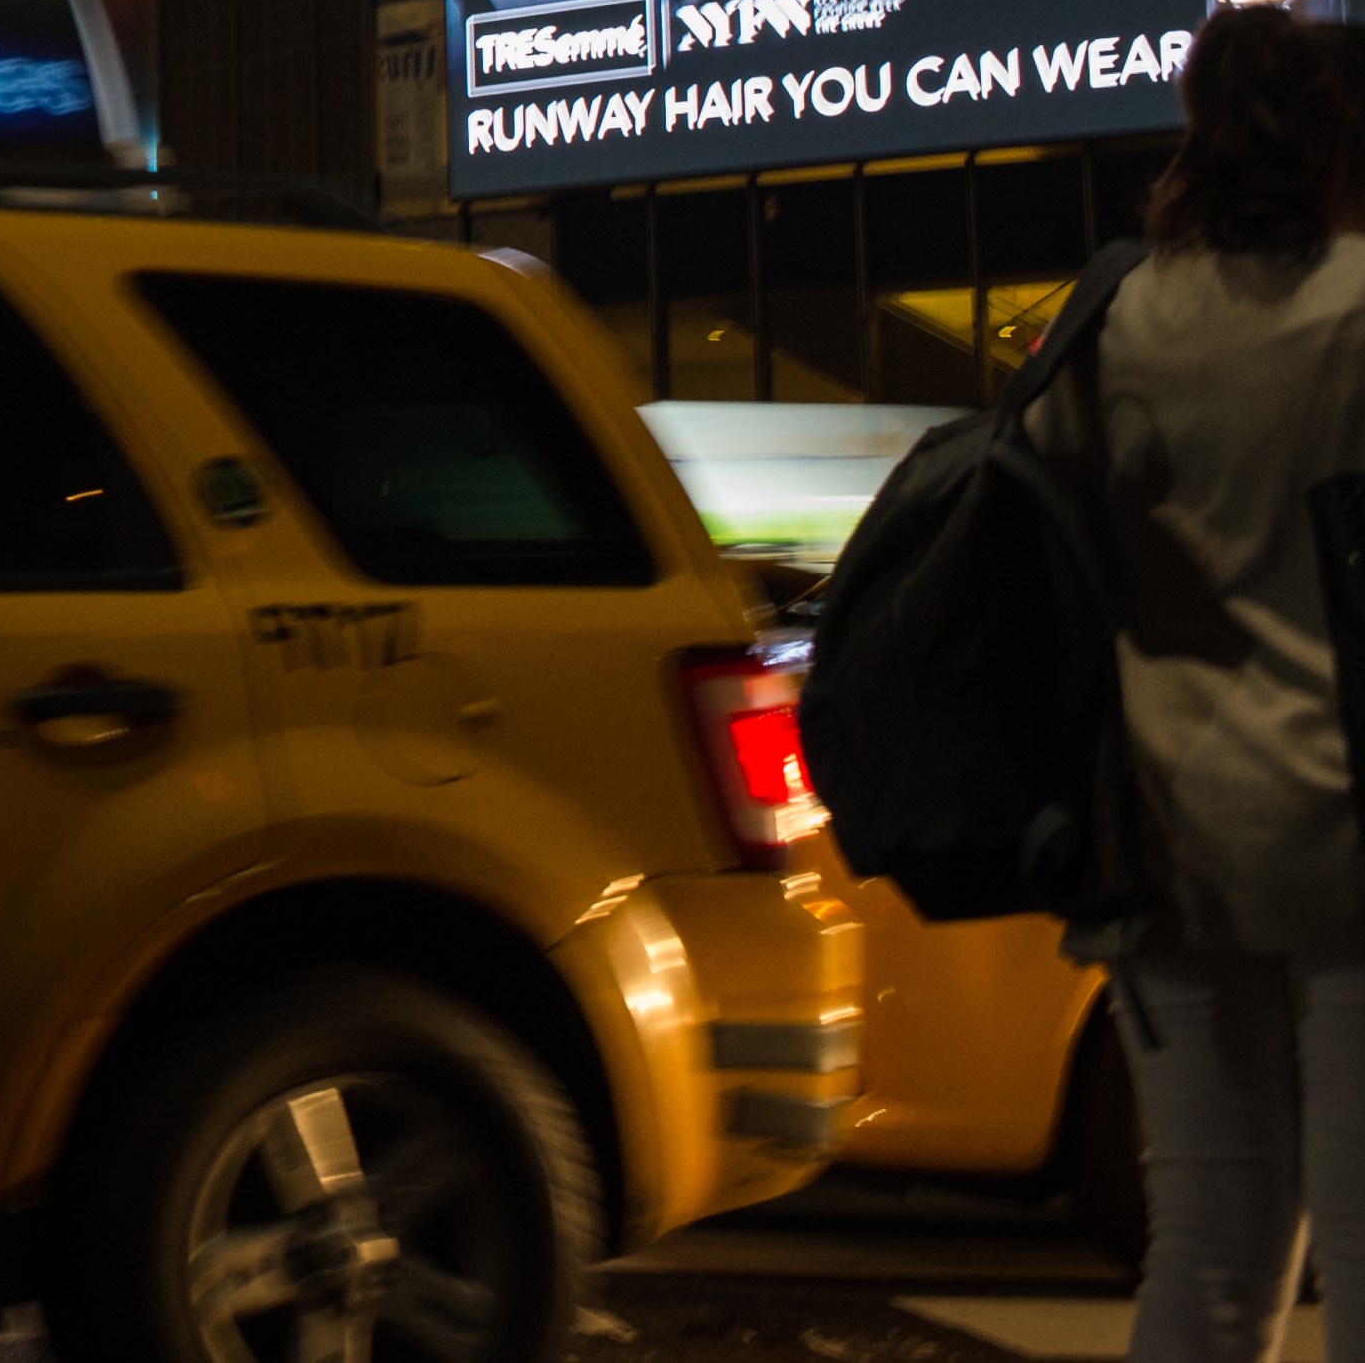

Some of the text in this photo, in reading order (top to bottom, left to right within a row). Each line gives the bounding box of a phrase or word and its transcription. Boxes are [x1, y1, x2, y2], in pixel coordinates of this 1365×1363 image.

[475, 14, 647, 75] TRESemmé
[468, 88, 656, 155] RUNWAY
[665, 75, 775, 133] HAIR
[781, 61, 892, 119] YOU
[906, 46, 1020, 107] CAN
[1032, 29, 1193, 93] WEAR
